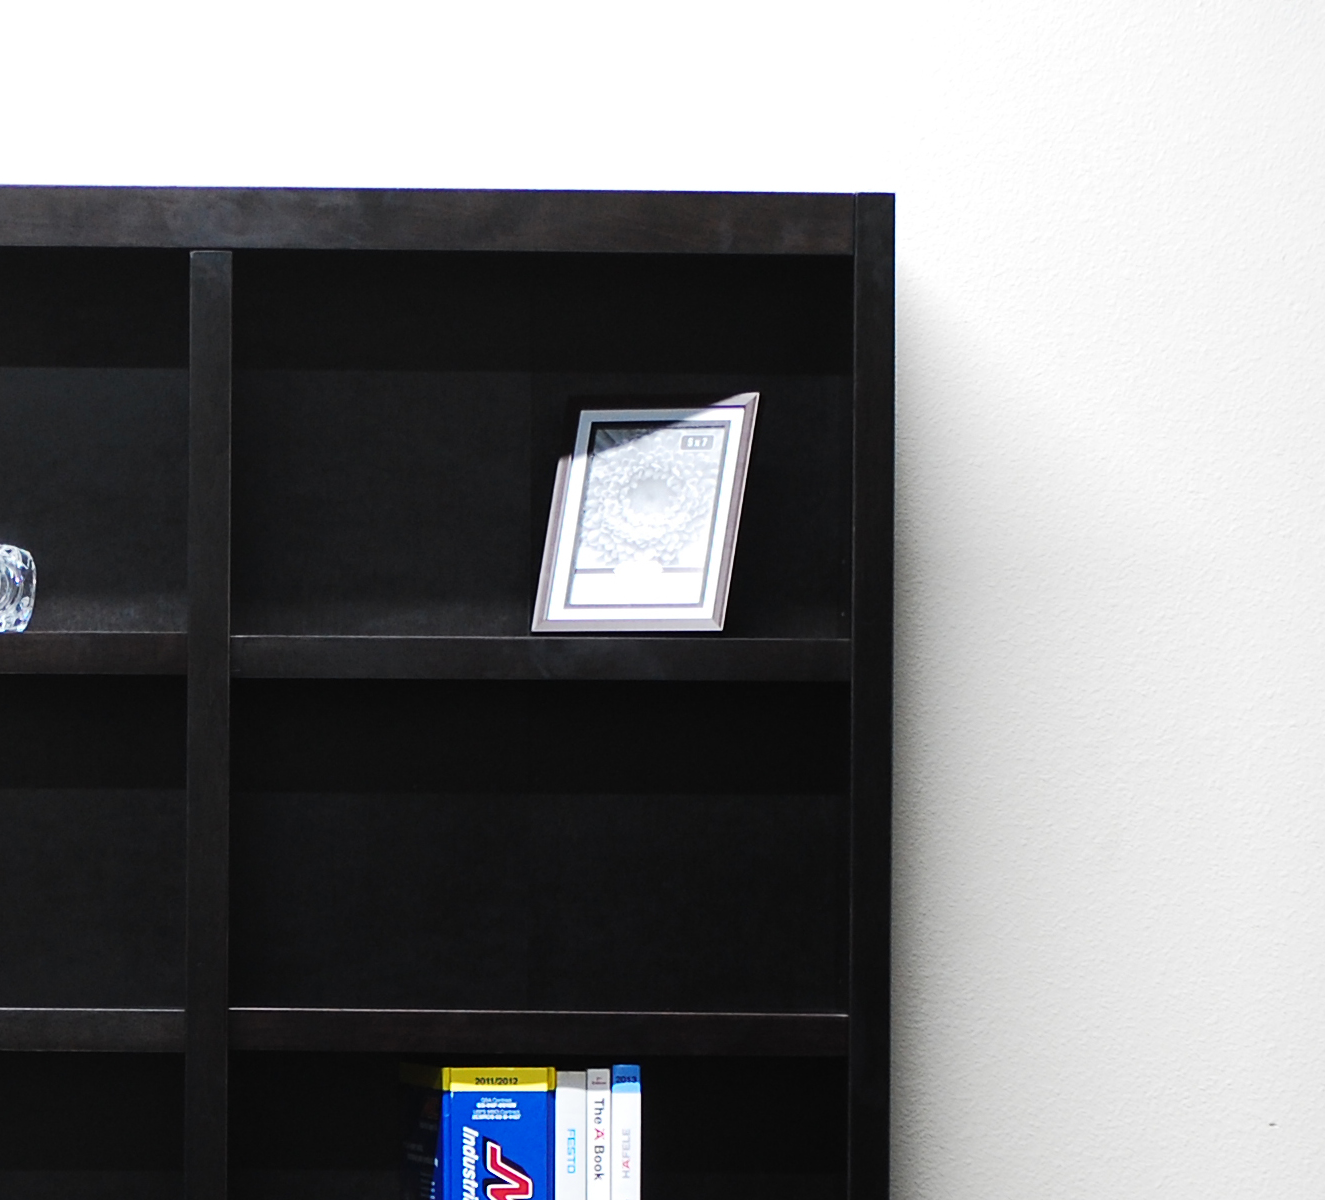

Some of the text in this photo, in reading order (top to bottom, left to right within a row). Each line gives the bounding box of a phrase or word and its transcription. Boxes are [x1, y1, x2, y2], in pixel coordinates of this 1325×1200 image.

[475, 1077, 518, 1085] 2011/2012
[594, 1098, 605, 1124] The
[567, 1129, 576, 1174] FESTO
[594, 1145, 605, 1180] Book
